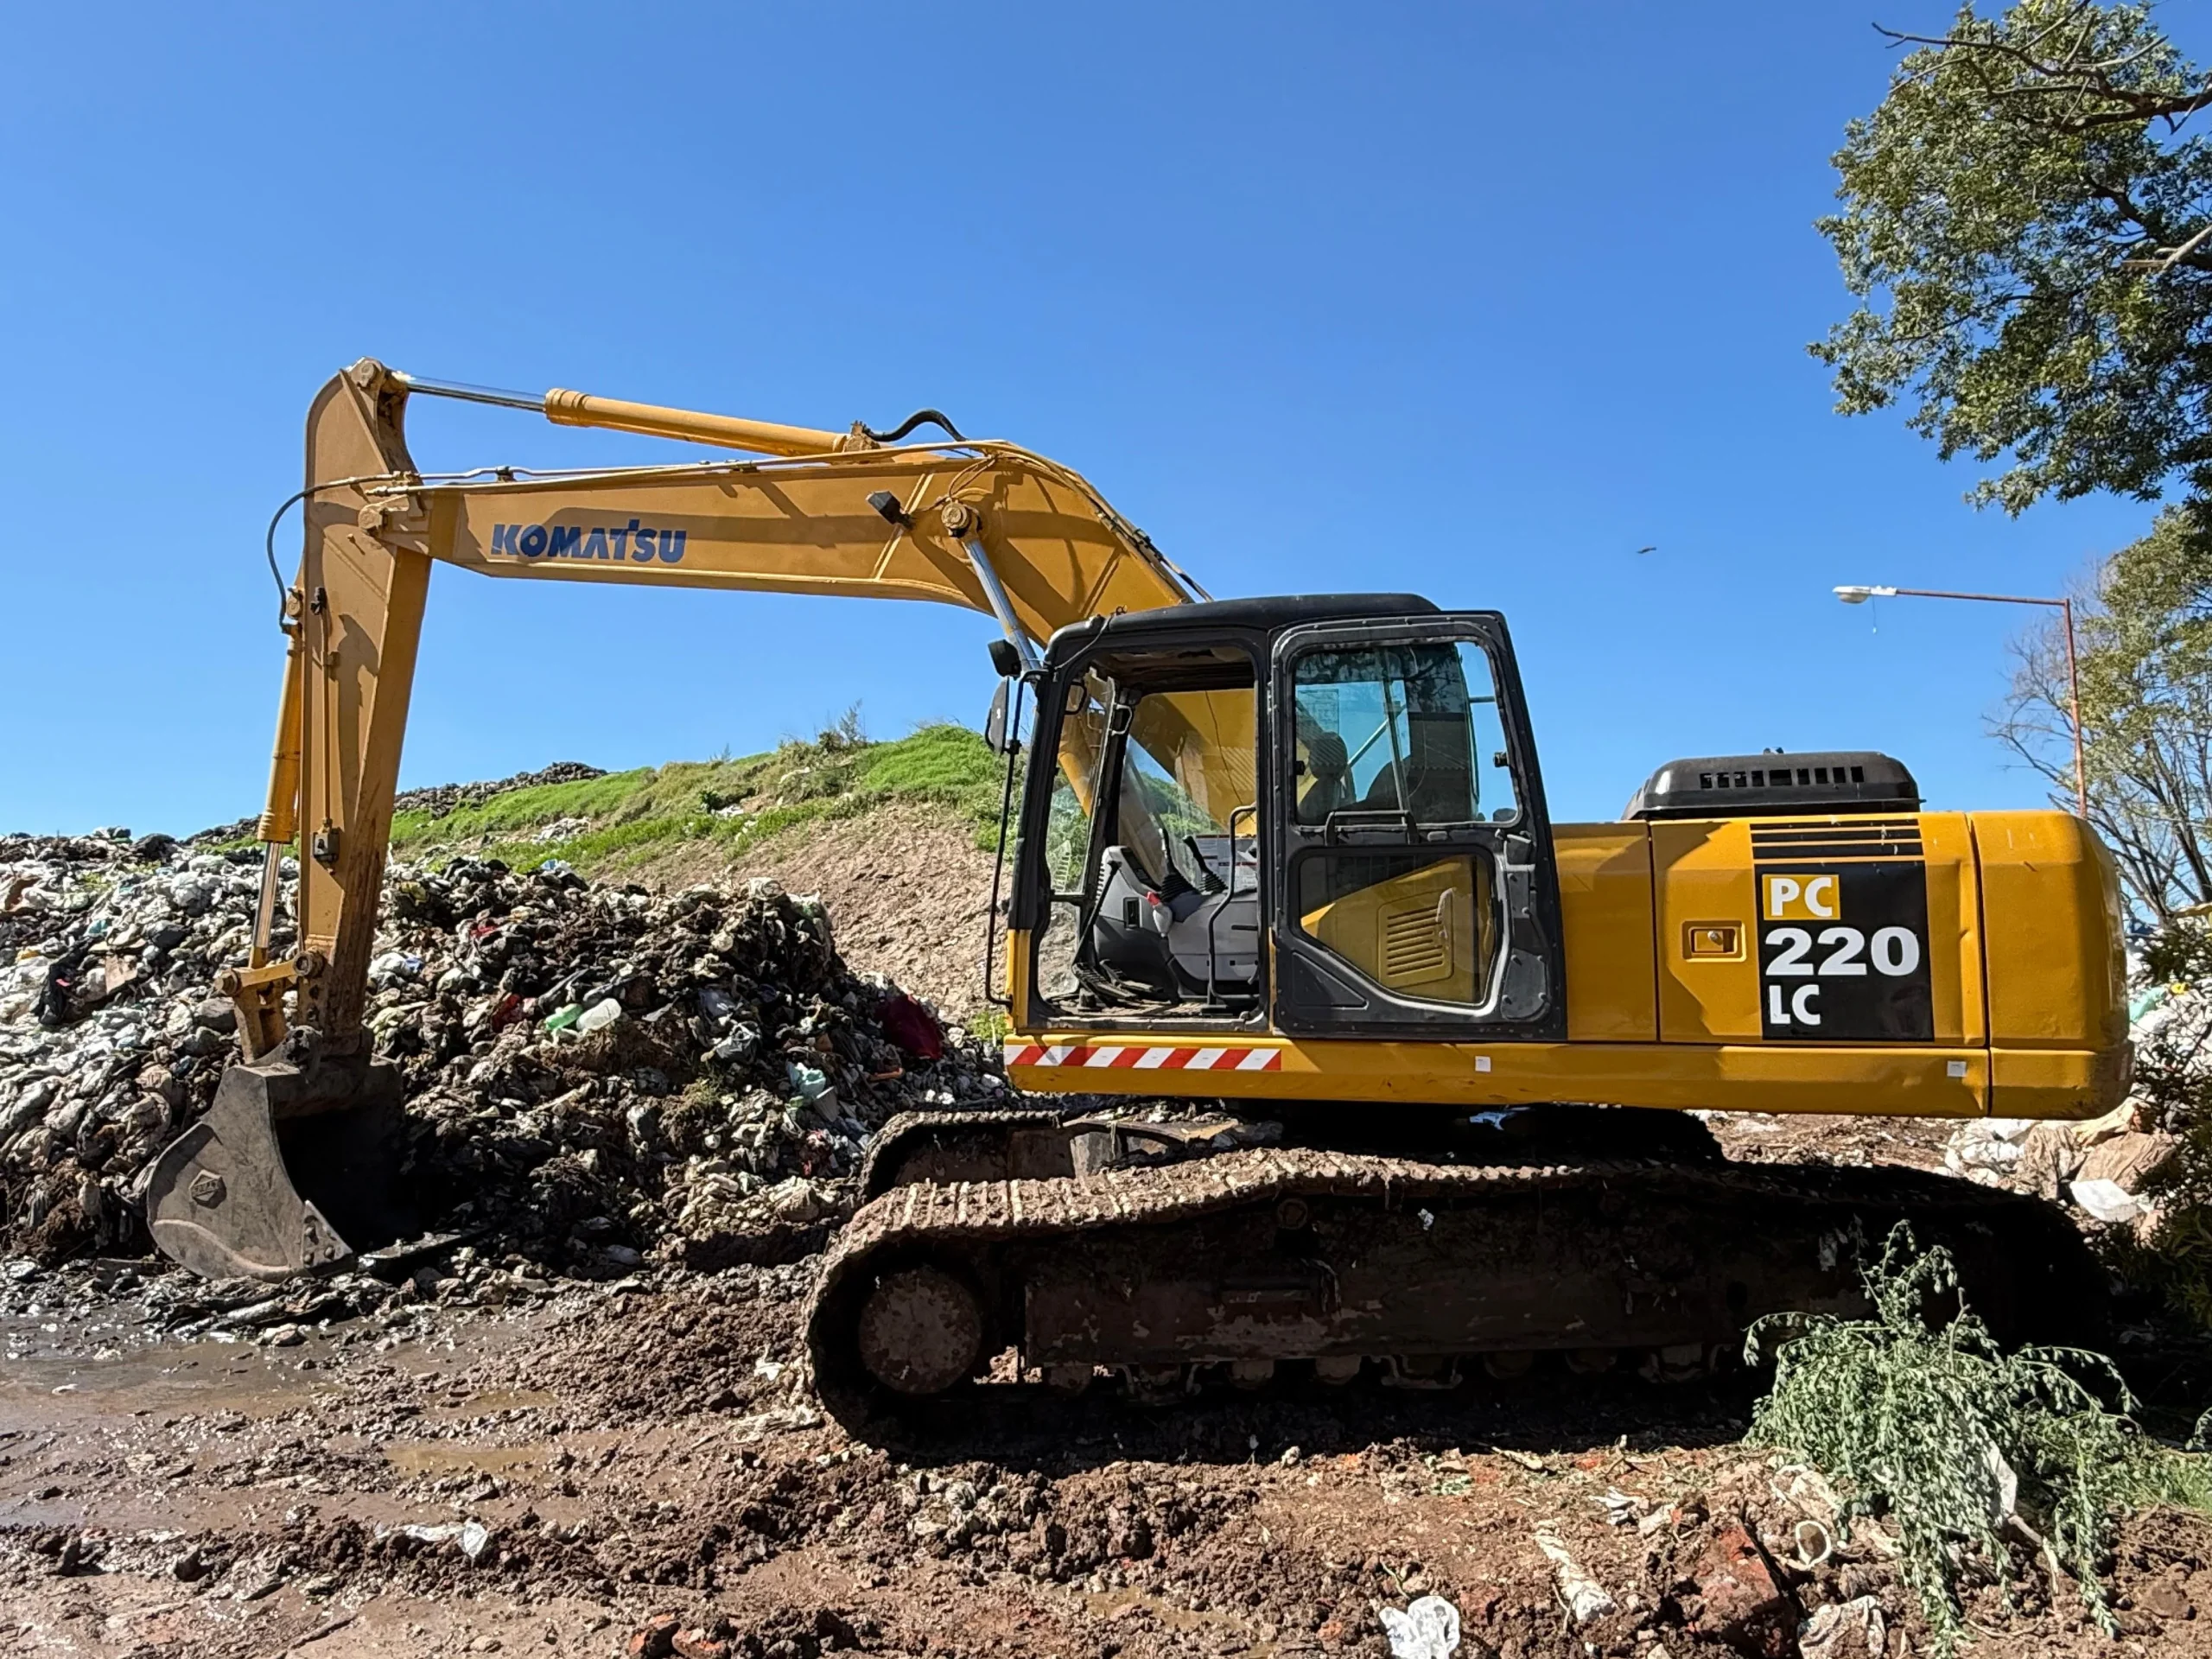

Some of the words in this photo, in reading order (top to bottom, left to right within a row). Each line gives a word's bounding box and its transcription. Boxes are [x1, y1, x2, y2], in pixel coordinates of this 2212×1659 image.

[491, 519, 687, 563] KOMATSU
[1770, 877, 1833, 917] PC
[1765, 926, 1920, 976] 220
[1769, 984, 1821, 1026] LC
